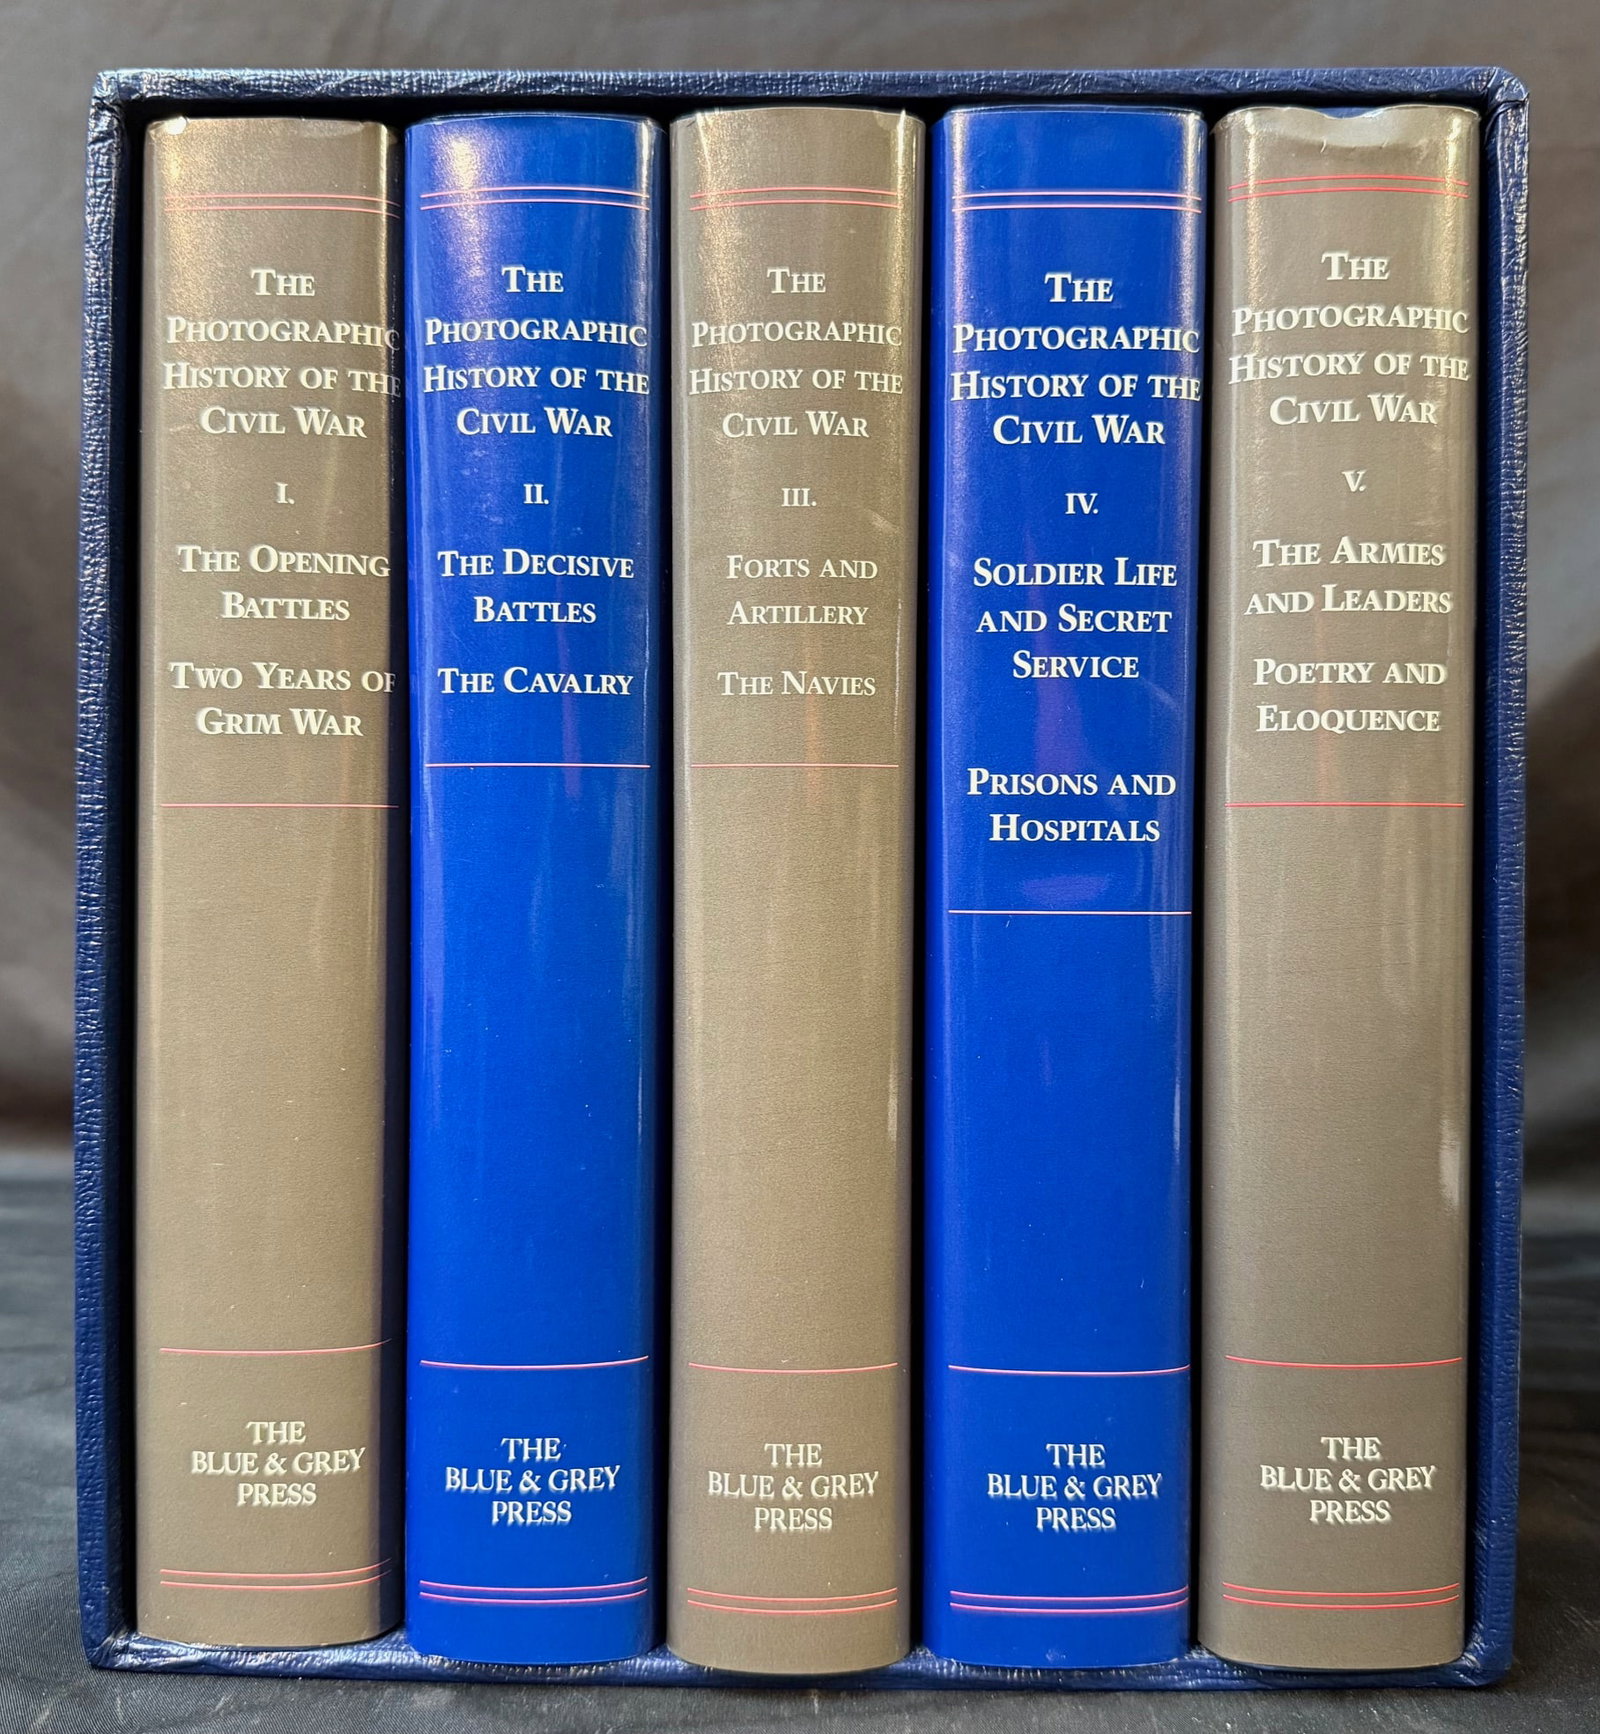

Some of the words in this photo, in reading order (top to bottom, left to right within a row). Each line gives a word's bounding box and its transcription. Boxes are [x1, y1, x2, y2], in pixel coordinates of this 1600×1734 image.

[1321, 250, 1389, 280] THE
[251, 268, 316, 297] THE
[502, 267, 564, 294] THE
[767, 268, 825, 293] THE
[1045, 273, 1113, 303] THE
[167, 317, 400, 352] PHOTOGRAPHIC
[425, 318, 648, 348] PHOTOGRAPHIC
[692, 321, 902, 347] PHOTOGRAPHIC
[1232, 306, 1469, 336] PHOTOGRAPHIC
[953, 323, 1199, 354] PHOTOGRAPHIC
[164, 361, 290, 390] HISTORY
[299, 368, 338, 390] OF
[347, 370, 401, 398] THE
[423, 364, 541, 392] HISTORY
[550, 367, 587, 389] OF
[596, 369, 649, 394] THE
[689, 368, 800, 394] HISTORY
[812, 369, 846, 389] OF
[854, 371, 903, 394] THE
[1229, 352, 1362, 384] HISTORY
[1374, 354, 1411, 375] OF
[1420, 356, 1469, 381] THE
[950, 371, 1088, 401] HISTORY
[1099, 373, 1138, 397] OF
[1148, 375, 1201, 402] THE
[200, 407, 285, 434] CIVIL
[293, 407, 367, 438] WAR
[457, 407, 534, 434] CIVIL
[543, 407, 612, 437] WAR
[1270, 396, 1360, 425] CIVIL
[1368, 393, 1437, 424] WAR
[722, 413, 797, 438] CIVIL
[806, 411, 869, 437] WAR
[993, 416, 1082, 445] CIVIL
[1092, 416, 1166, 445] WAR
[276, 482, 294, 504] I.
[524, 483, 549, 504] II.
[1342, 470, 1366, 492] V.
[782, 488, 816, 507] III.
[1066, 493, 1099, 515] IV.
[178, 546, 240, 572] THE
[249, 545, 390, 577] OPENING
[438, 551, 494, 576] THE
[503, 548, 634, 578] DECISIVE
[1253, 539, 1319, 567] THE
[1331, 536, 1447, 567] ARMIES
[726, 554, 810, 580] FORTS
[820, 558, 878, 580] AND
[973, 557, 1104, 586] SOLDIER
[1114, 557, 1177, 586] LIFE
[221, 591, 350, 620] BATTLES
[474, 596, 596, 623] BATTLES
[727, 600, 868, 625] ARTILLERY
[1244, 591, 1314, 614] AND
[1321, 584, 1453, 614] LEADERS
[977, 610, 1047, 632] AND
[1058, 603, 1172, 633] SECRET
[170, 663, 242, 689] TWO
[253, 663, 351, 690] YEARS
[362, 672, 396, 692] OF
[1013, 650, 1139, 679] SERVICE
[1253, 658, 1373, 685] POETRY
[1382, 663, 1448, 685] AND
[438, 668, 494, 693] THE
[504, 666, 633, 696] CAVALRY
[718, 672, 773, 695] THE
[781, 672, 876, 696] NAVIES
[197, 707, 281, 735] GRIM
[290, 708, 362, 737] WAR
[1256, 705, 1441, 734] ELOQUENCE
[968, 768, 1098, 796] PRISONS
[1108, 773, 1176, 795] AND
[990, 814, 1160, 842] HOSPITALS
[245, 1421, 306, 1445] THE
[192, 1450, 261, 1475] BLUE
[264, 1451, 288, 1475] &
[294, 1447, 366, 1475] GREY
[501, 1437, 560, 1461] THE
[763, 1441, 824, 1468] THE
[1046, 1443, 1105, 1467] THE
[1321, 1436, 1381, 1460] THE
[445, 1467, 513, 1493] BLUE
[520, 1469, 542, 1493] &
[547, 1465, 621, 1493] GREY
[708, 1472, 775, 1498] BLUE
[781, 1473, 804, 1498] &
[810, 1470, 880, 1498] GREY
[987, 1473, 1057, 1498] BLUE
[1064, 1475, 1085, 1497] &
[1092, 1472, 1163, 1498] GREY
[1260, 1466, 1332, 1491] BLUE
[1338, 1467, 1360, 1491] &
[1367, 1465, 1437, 1491] GREY
[237, 1482, 317, 1506] PRESS
[492, 1501, 571, 1526] PRESS
[754, 1506, 833, 1531] PRESS
[1036, 1506, 1116, 1530] PRESS
[1310, 1498, 1391, 1522] PRESS
